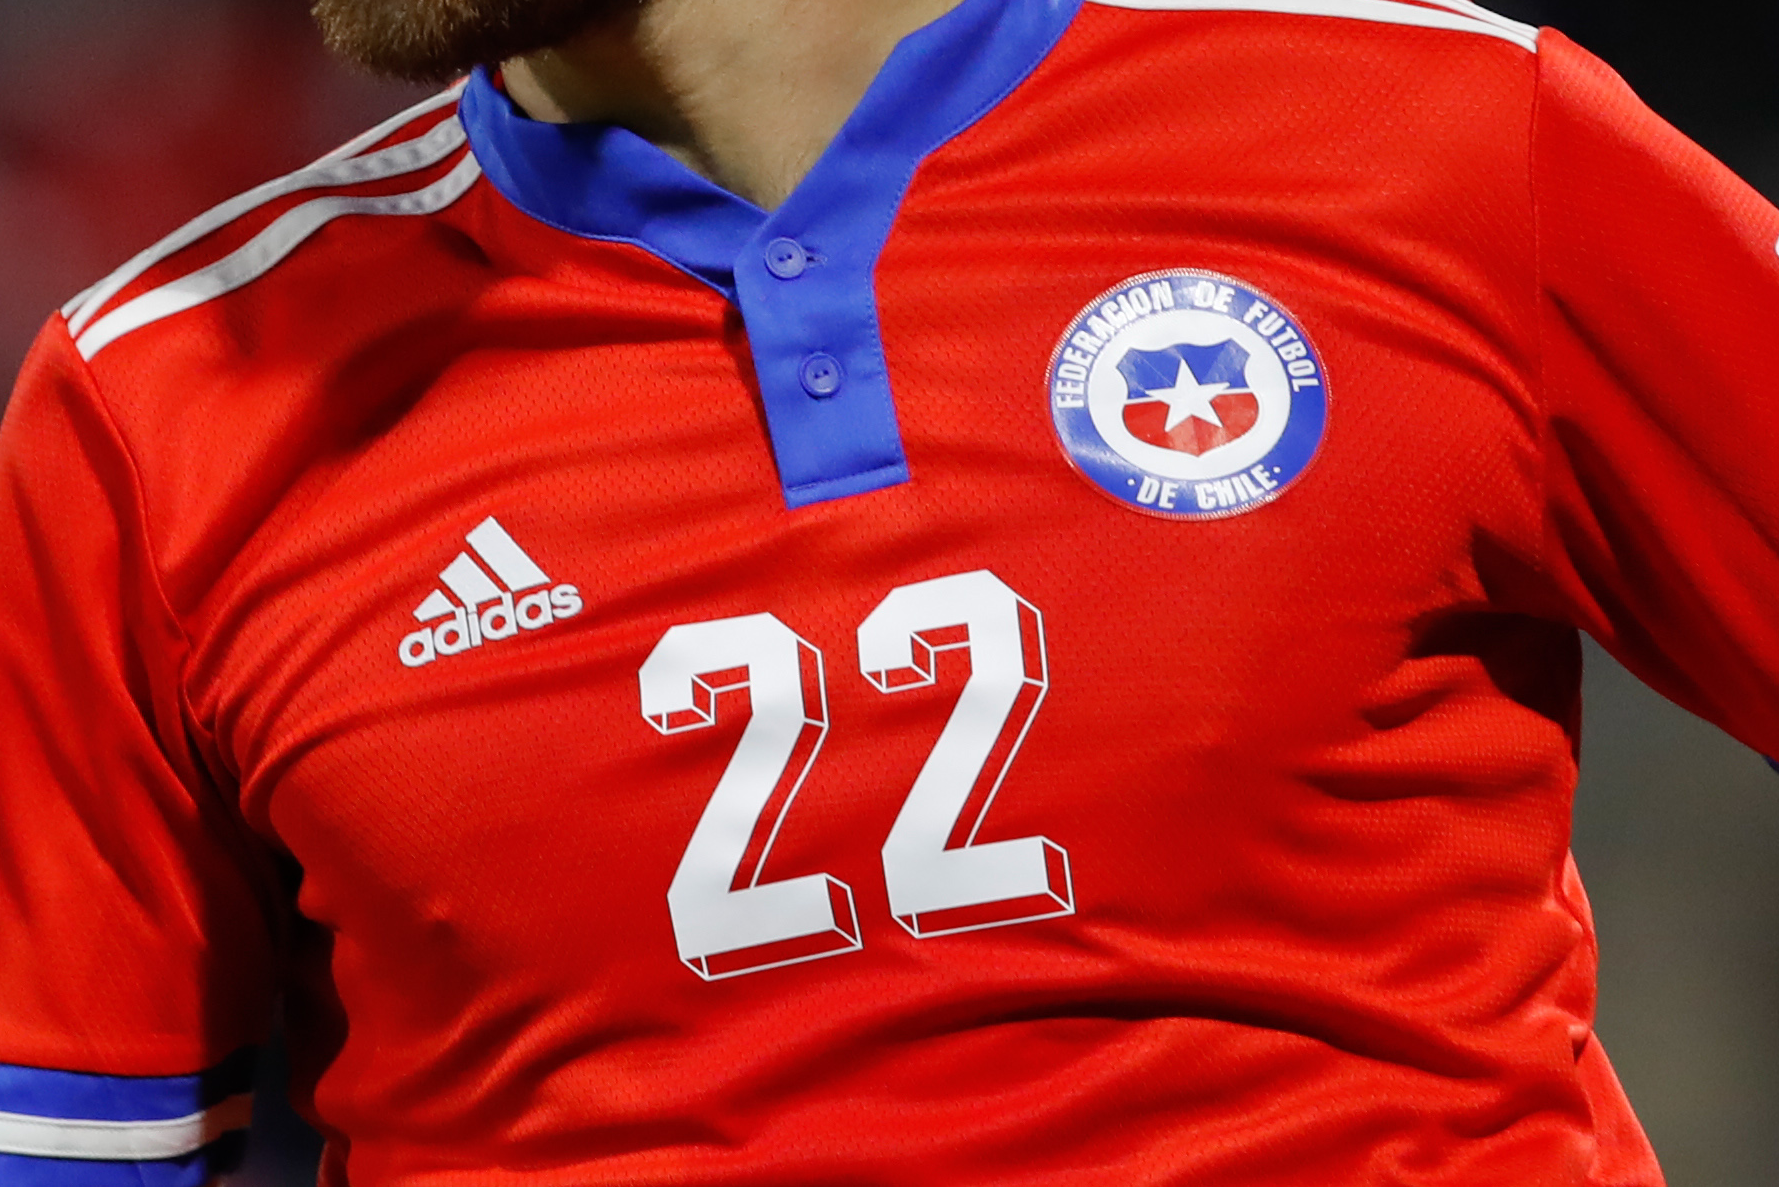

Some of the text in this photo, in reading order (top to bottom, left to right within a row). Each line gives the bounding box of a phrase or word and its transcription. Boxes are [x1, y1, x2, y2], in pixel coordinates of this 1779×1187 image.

[1055, 280, 1320, 409] FEDERACION DE FUTBOL
[1136, 464, 1279, 511] DE CHILE
[397, 583, 584, 668] adidas
[637, 568, 1077, 983] 22
